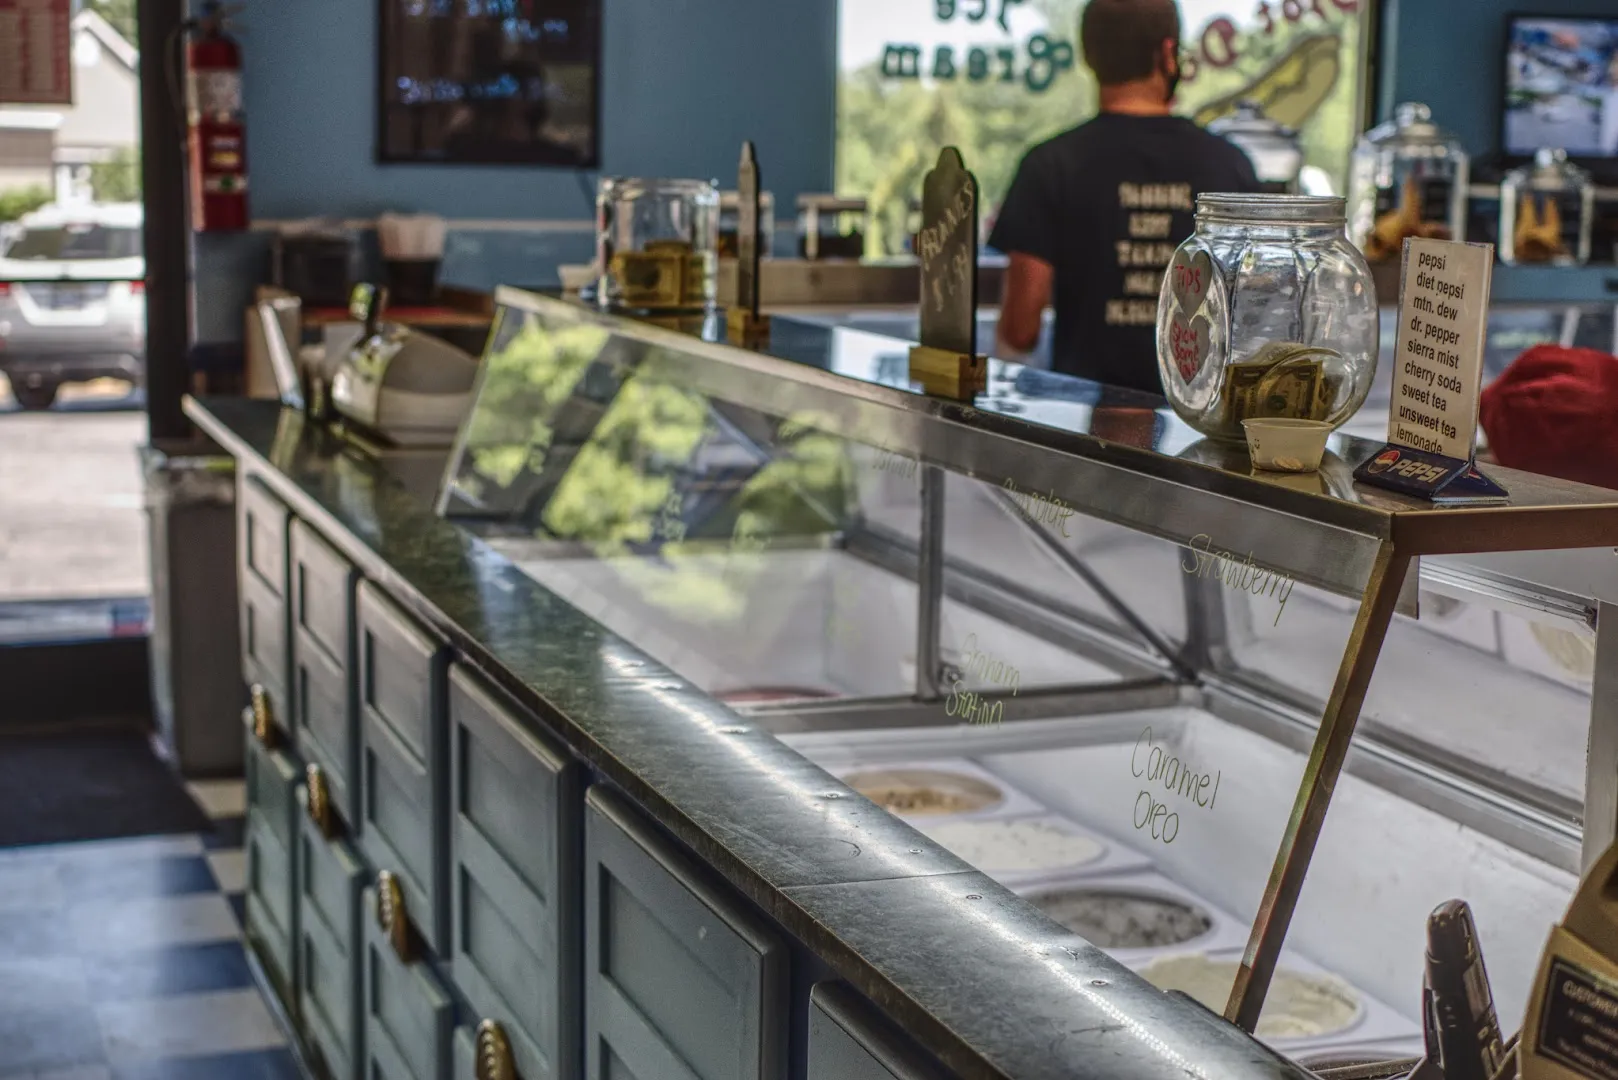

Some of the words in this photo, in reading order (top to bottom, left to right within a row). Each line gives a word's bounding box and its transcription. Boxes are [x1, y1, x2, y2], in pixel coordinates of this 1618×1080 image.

[1418, 252, 1446, 271] pepsi
[1416, 271, 1435, 290] diet
[1436, 280, 1464, 300] pepsi
[1413, 296, 1434, 314] mtn.
[1437, 301, 1458, 321] dew
[1410, 315, 1422, 333] dr.
[1424, 323, 1460, 345] pepper
[1407, 339, 1434, 360] sierra
[1437, 350, 1459, 369] mist
[1404, 360, 1435, 386] cherry
[1437, 374, 1462, 394] soda
[1402, 383, 1430, 405] sweet
[1432, 392, 1447, 412] tea
[1399, 405, 1439, 432] unsweet
[1441, 420, 1456, 439] tea
[1396, 423, 1442, 455] lemonade
[1387, 458, 1449, 483] PEPSI
[1181, 533, 1295, 628] Strawberry
[1131, 726, 1221, 810] Caramel
[1133, 790, 1179, 844] Oreo
